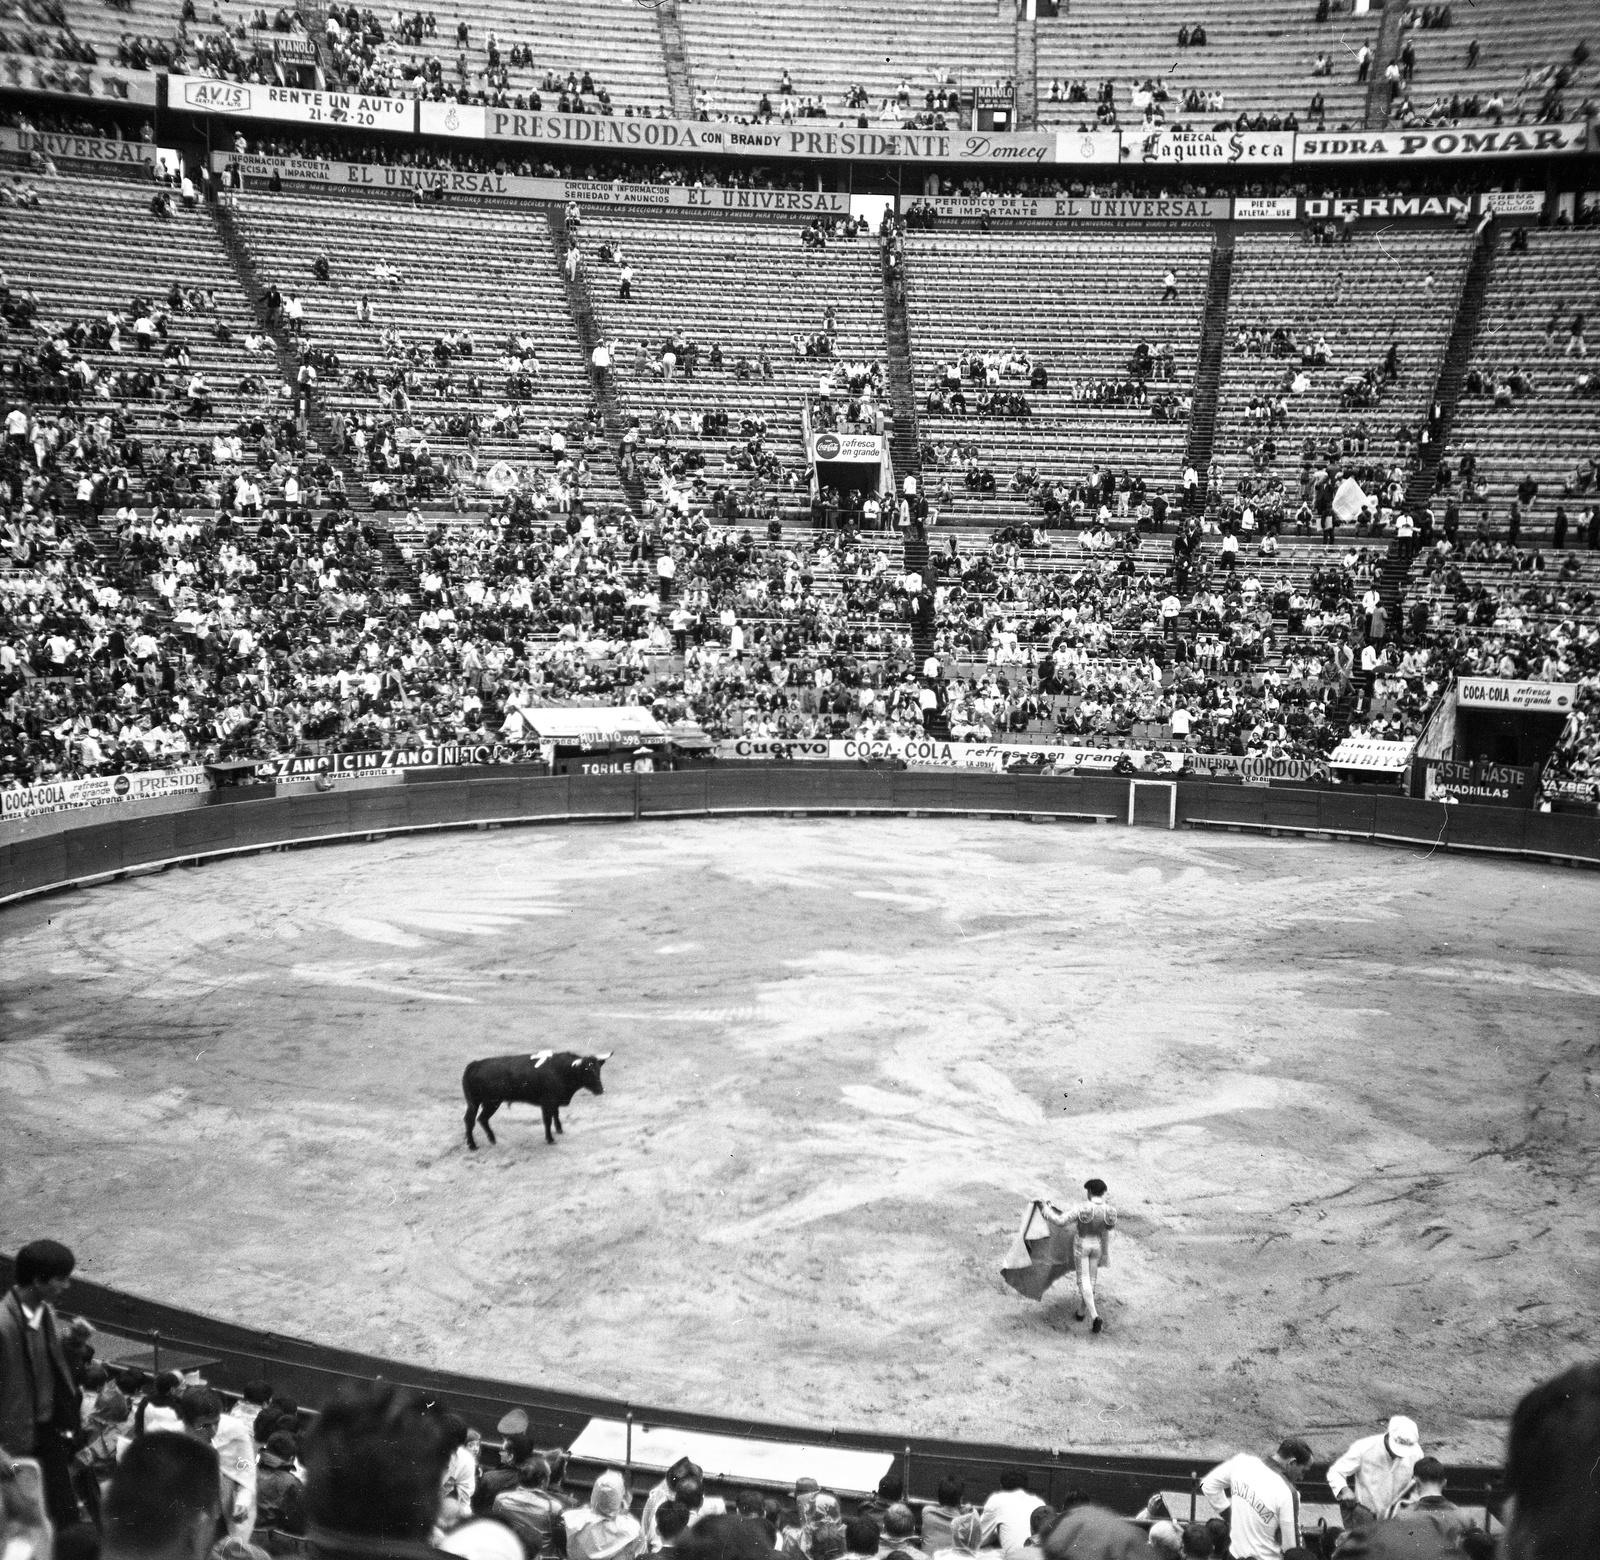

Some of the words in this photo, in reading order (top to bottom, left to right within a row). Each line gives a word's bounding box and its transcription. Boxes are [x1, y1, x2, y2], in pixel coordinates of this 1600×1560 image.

[279, 40, 315, 54] MANOLO
[195, 86, 242, 102] AVIS
[978, 87, 1013, 98] MANOLO
[269, 89, 322, 106] RENTE
[329, 95, 350, 109] UN
[358, 98, 404, 114] AUTO
[493, 113, 698, 147] PRESIDENSODA
[1173, 133, 1217, 142] MEZCAL
[701, 132, 722, 144] CON
[731, 134, 781, 147] BRANDY
[789, 131, 950, 157] PRESIDENTE
[960, 136, 1048, 163] Domecq
[1141, 132, 1223, 163] Laguna
[1227, 132, 1283, 163] Seca
[1304, 139, 1389, 155] SIDRA
[1400, 128, 1568, 155] POMAR
[229, 155, 285, 167] INFORMACION
[291, 160, 330, 171] ESCUETA
[285, 168, 329, 180] IMPARCIAL
[347, 165, 374, 183] EL
[385, 168, 507, 193] UNIVERSAL
[565, 181, 613, 192] CIRCULACION
[617, 184, 670, 195] INFORMACION
[565, 190, 609, 201] SERIEDAD
[615, 193, 620, 201] Y
[624, 194, 670, 203] ANUNCIOS
[687, 188, 712, 206] EL
[722, 190, 842, 211] UNIVERSAL
[935, 198, 995, 207] PERIODICO
[1002, 199, 1016, 207] DE
[1022, 199, 1038, 207] LA
[1251, 200, 1264, 208] PIE
[1267, 200, 1277, 208] DE
[960, 207, 1038, 216] IMPRTANTE
[1055, 200, 1079, 216] EL
[1091, 200, 1213, 217] UNIVERSAL
[1276, 209, 1290, 217] USE
[853, 448, 880, 458] grande
[1463, 685, 1510, 702] COCA-COLA
[1517, 686, 1551, 696] refresca
[1524, 696, 1552, 707] grande
[580, 731, 621, 744] MULATO
[622, 734, 640, 745] 398
[735, 740, 827, 756] Cuervo
[343, 750, 433, 769] CINZANO
[1075, 751, 1124, 764] grand
[1187, 755, 1239, 771] GINEBRA
[255, 757, 329, 776] INZANO
[582, 762, 632, 775] TORILE
[1241, 756, 1327, 779] GORDON'S
[73, 780, 108, 791] refresca
[139, 773, 212, 792] PRESIDEN
[1541, 779, 1595, 795] YAZBEK
[5, 786, 66, 811] COCA-COLA
[69, 792, 79, 800] en
[81, 787, 111, 800] grande
[1446, 783, 1509, 799] UADRILLAS
[1231, 1480, 1275, 1524] ANADA
